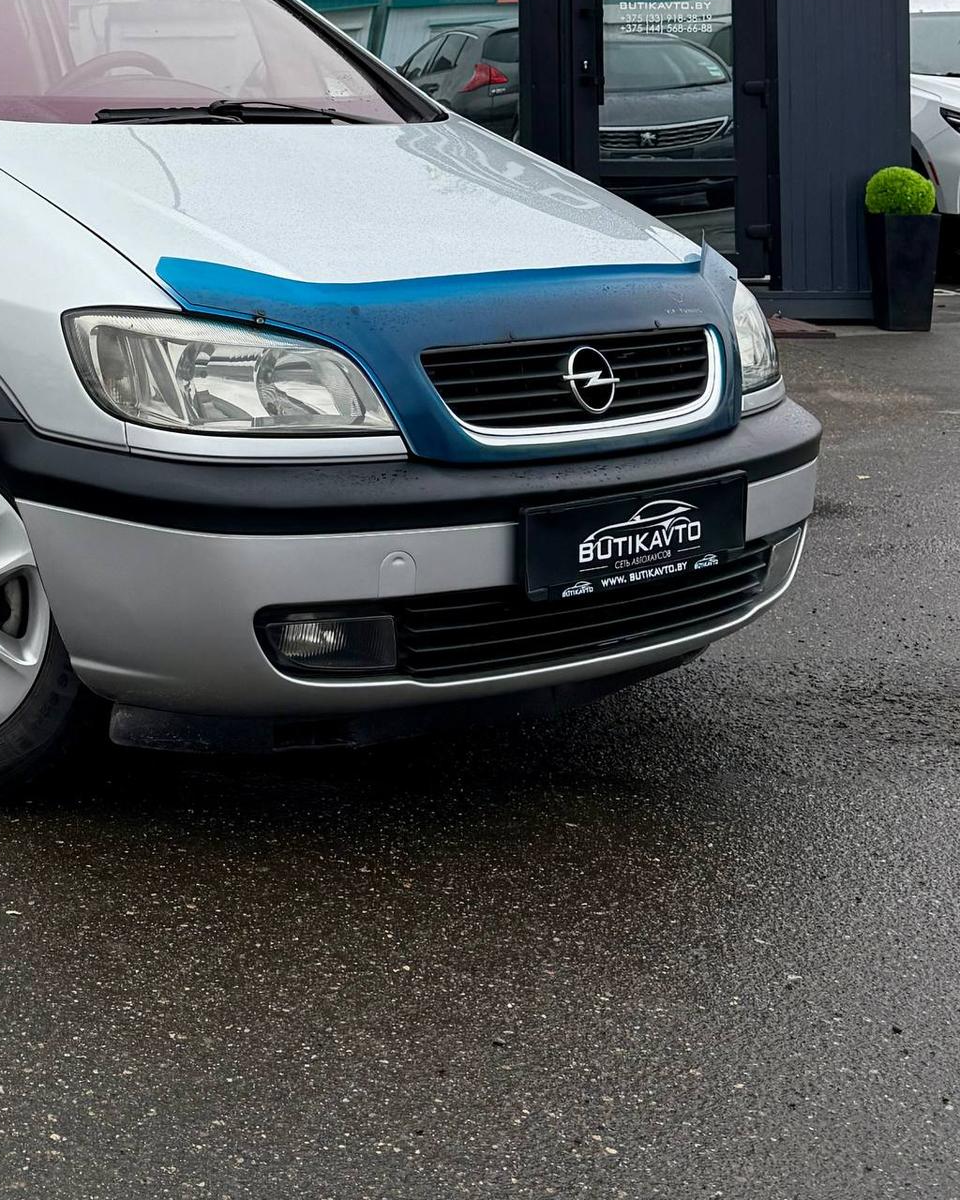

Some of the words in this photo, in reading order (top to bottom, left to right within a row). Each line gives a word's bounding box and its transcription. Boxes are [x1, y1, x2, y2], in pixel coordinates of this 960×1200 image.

[619, 1, 711, 10] BUTIKAVTO.BY
[620, 23, 643, 33] +375
[579, 521, 701, 563] BUTIKAVTO
[614, 558, 631, 570] СЕТЬ
[601, 575, 627, 588] WWW.
[629, 561, 688, 583] BUTIKAVTO.BY
